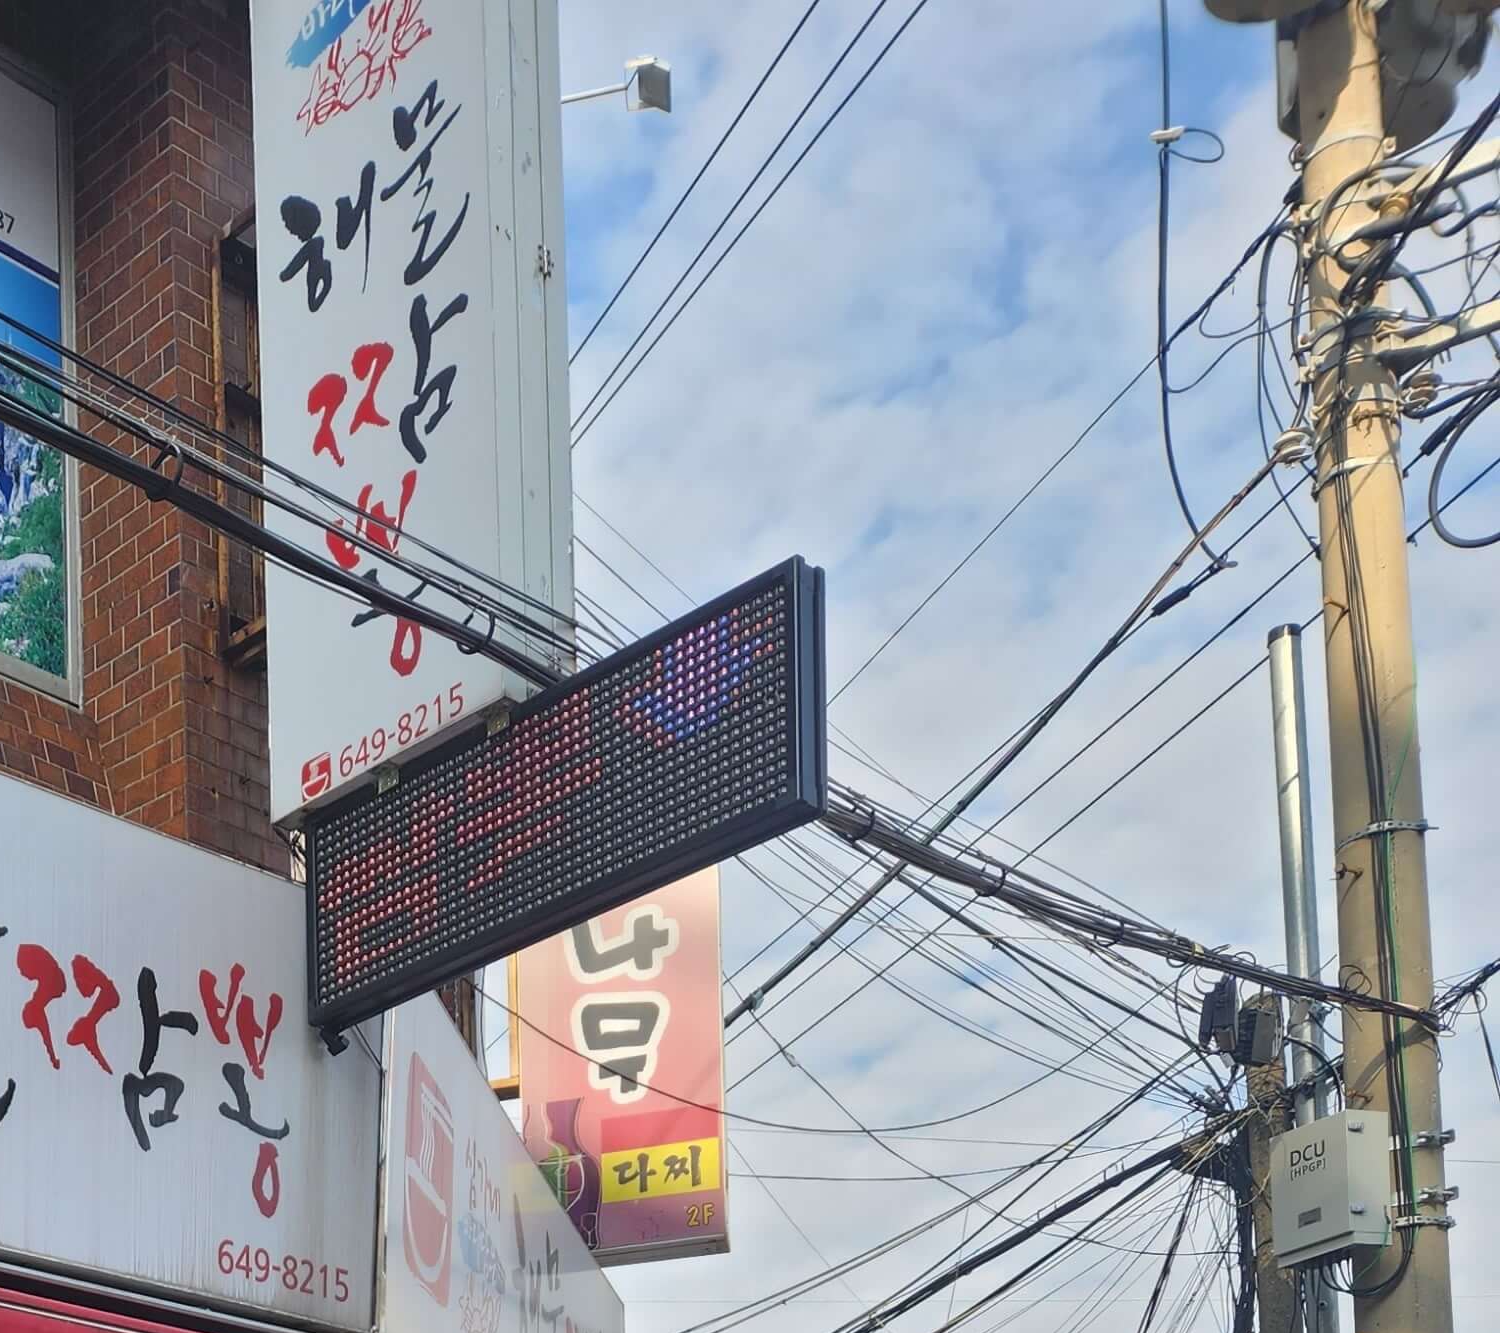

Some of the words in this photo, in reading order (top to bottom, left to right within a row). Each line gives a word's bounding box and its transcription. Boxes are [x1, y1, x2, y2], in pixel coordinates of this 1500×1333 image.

[338, 680, 467, 779] 649-8215
[613, 1144, 702, 1193] 다찌
[1288, 1139, 1327, 1169] DCU
[685, 1203, 715, 1228] 2F
[216, 1236, 351, 1304] 649-8215
